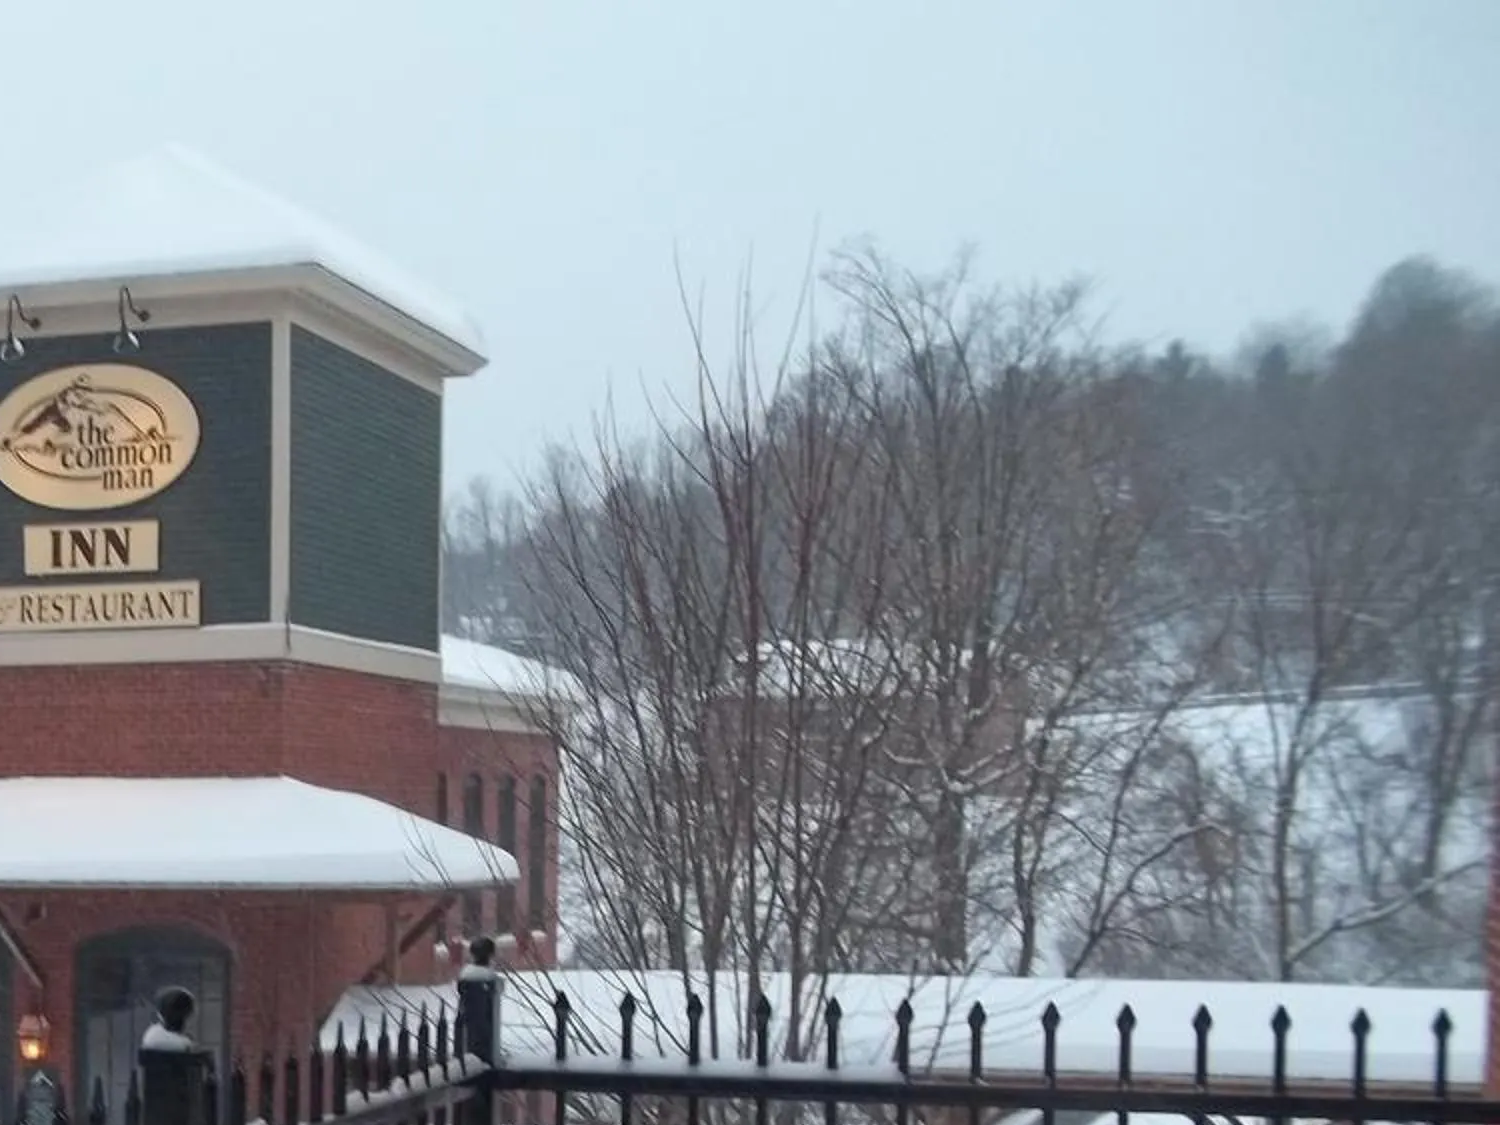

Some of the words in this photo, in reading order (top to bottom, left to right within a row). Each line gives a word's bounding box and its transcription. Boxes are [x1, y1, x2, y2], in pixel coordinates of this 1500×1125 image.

[77, 415, 115, 445] the
[60, 442, 172, 468] common
[102, 467, 153, 490] man
[50, 527, 132, 569] INN
[19, 590, 195, 624] RESTAURANT
